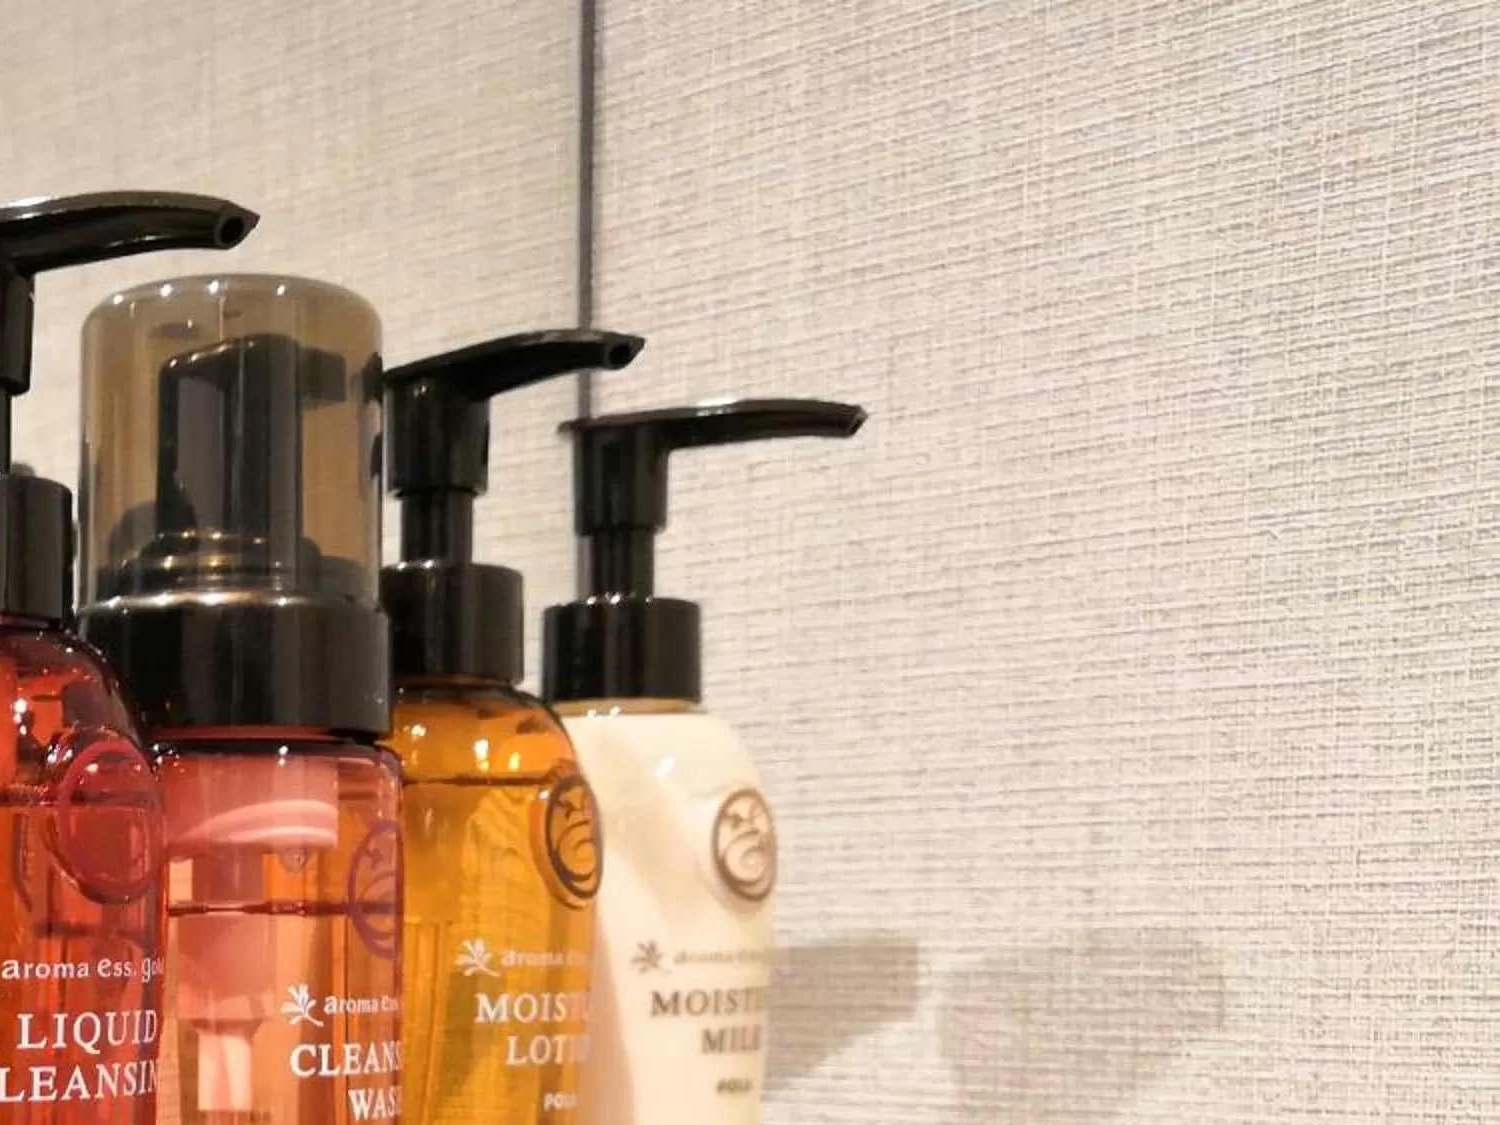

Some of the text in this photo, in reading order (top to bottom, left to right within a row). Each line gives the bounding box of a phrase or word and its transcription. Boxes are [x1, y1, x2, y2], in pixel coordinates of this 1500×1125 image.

[1, 959, 90, 980] aroma
[97, 956, 137, 978] ess.
[16, 1008, 158, 1055] LIQUID
